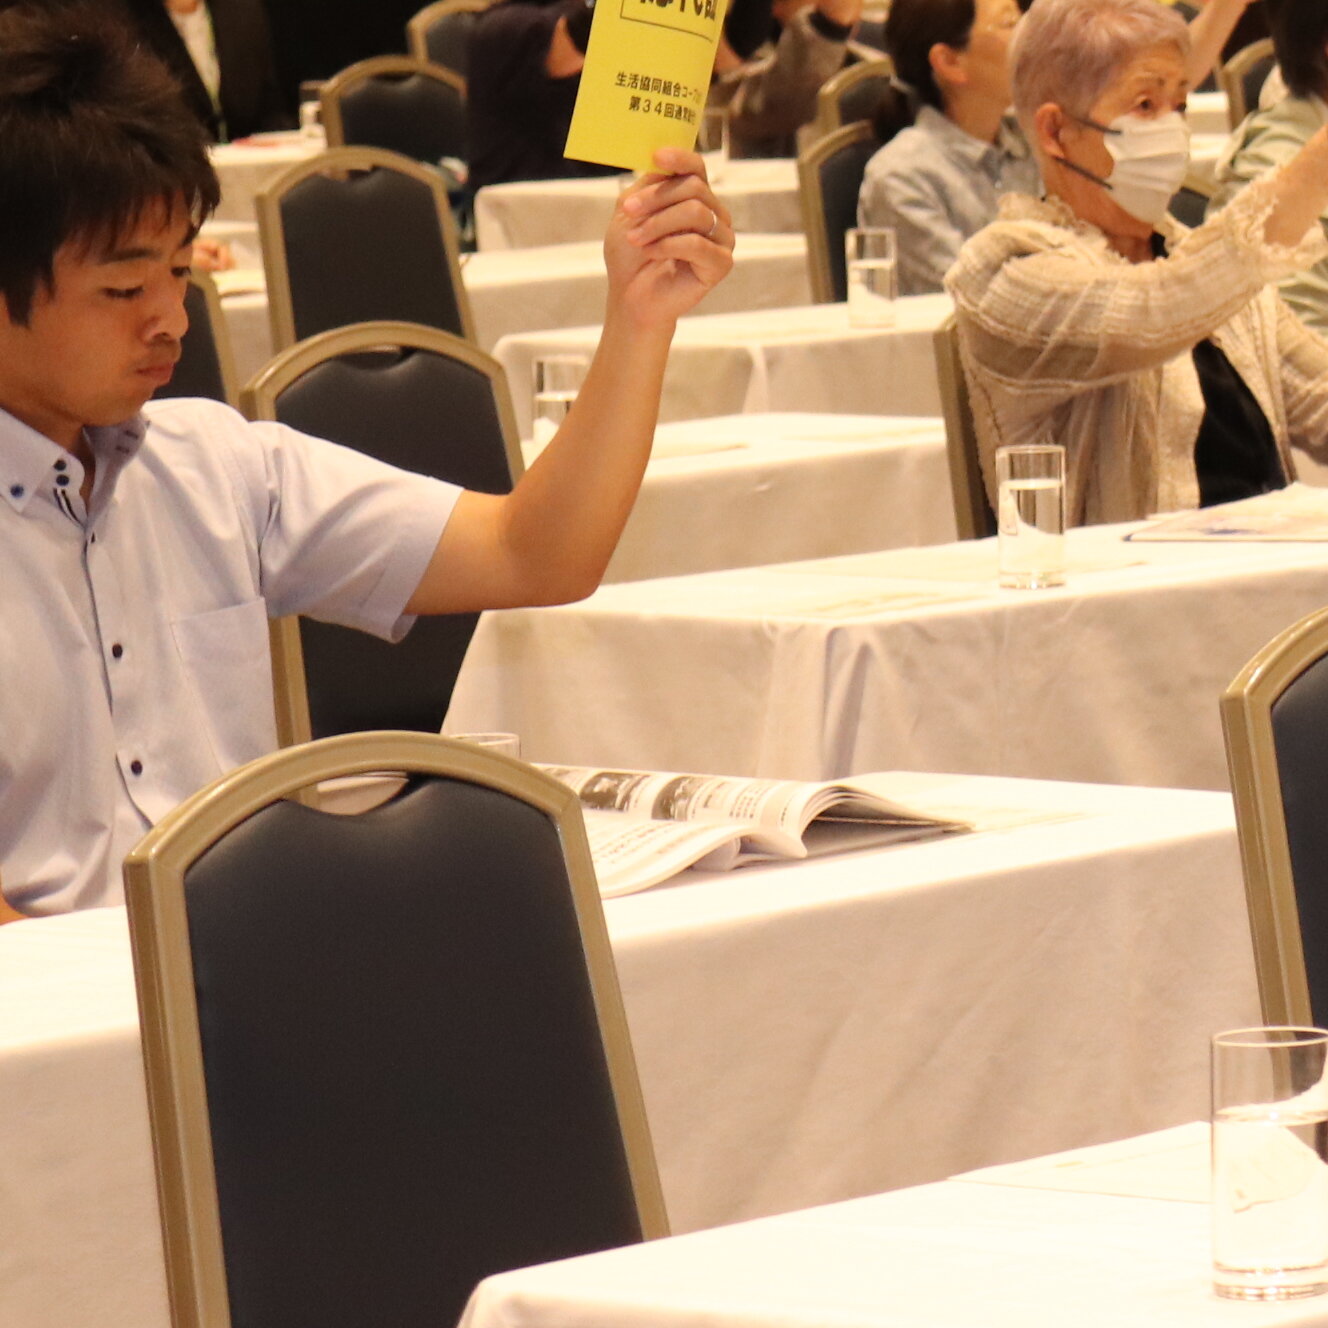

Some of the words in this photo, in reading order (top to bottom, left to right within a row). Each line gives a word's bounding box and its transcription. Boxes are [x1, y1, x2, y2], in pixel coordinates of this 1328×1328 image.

[614, 71, 703, 105] 生活協同組合コー
